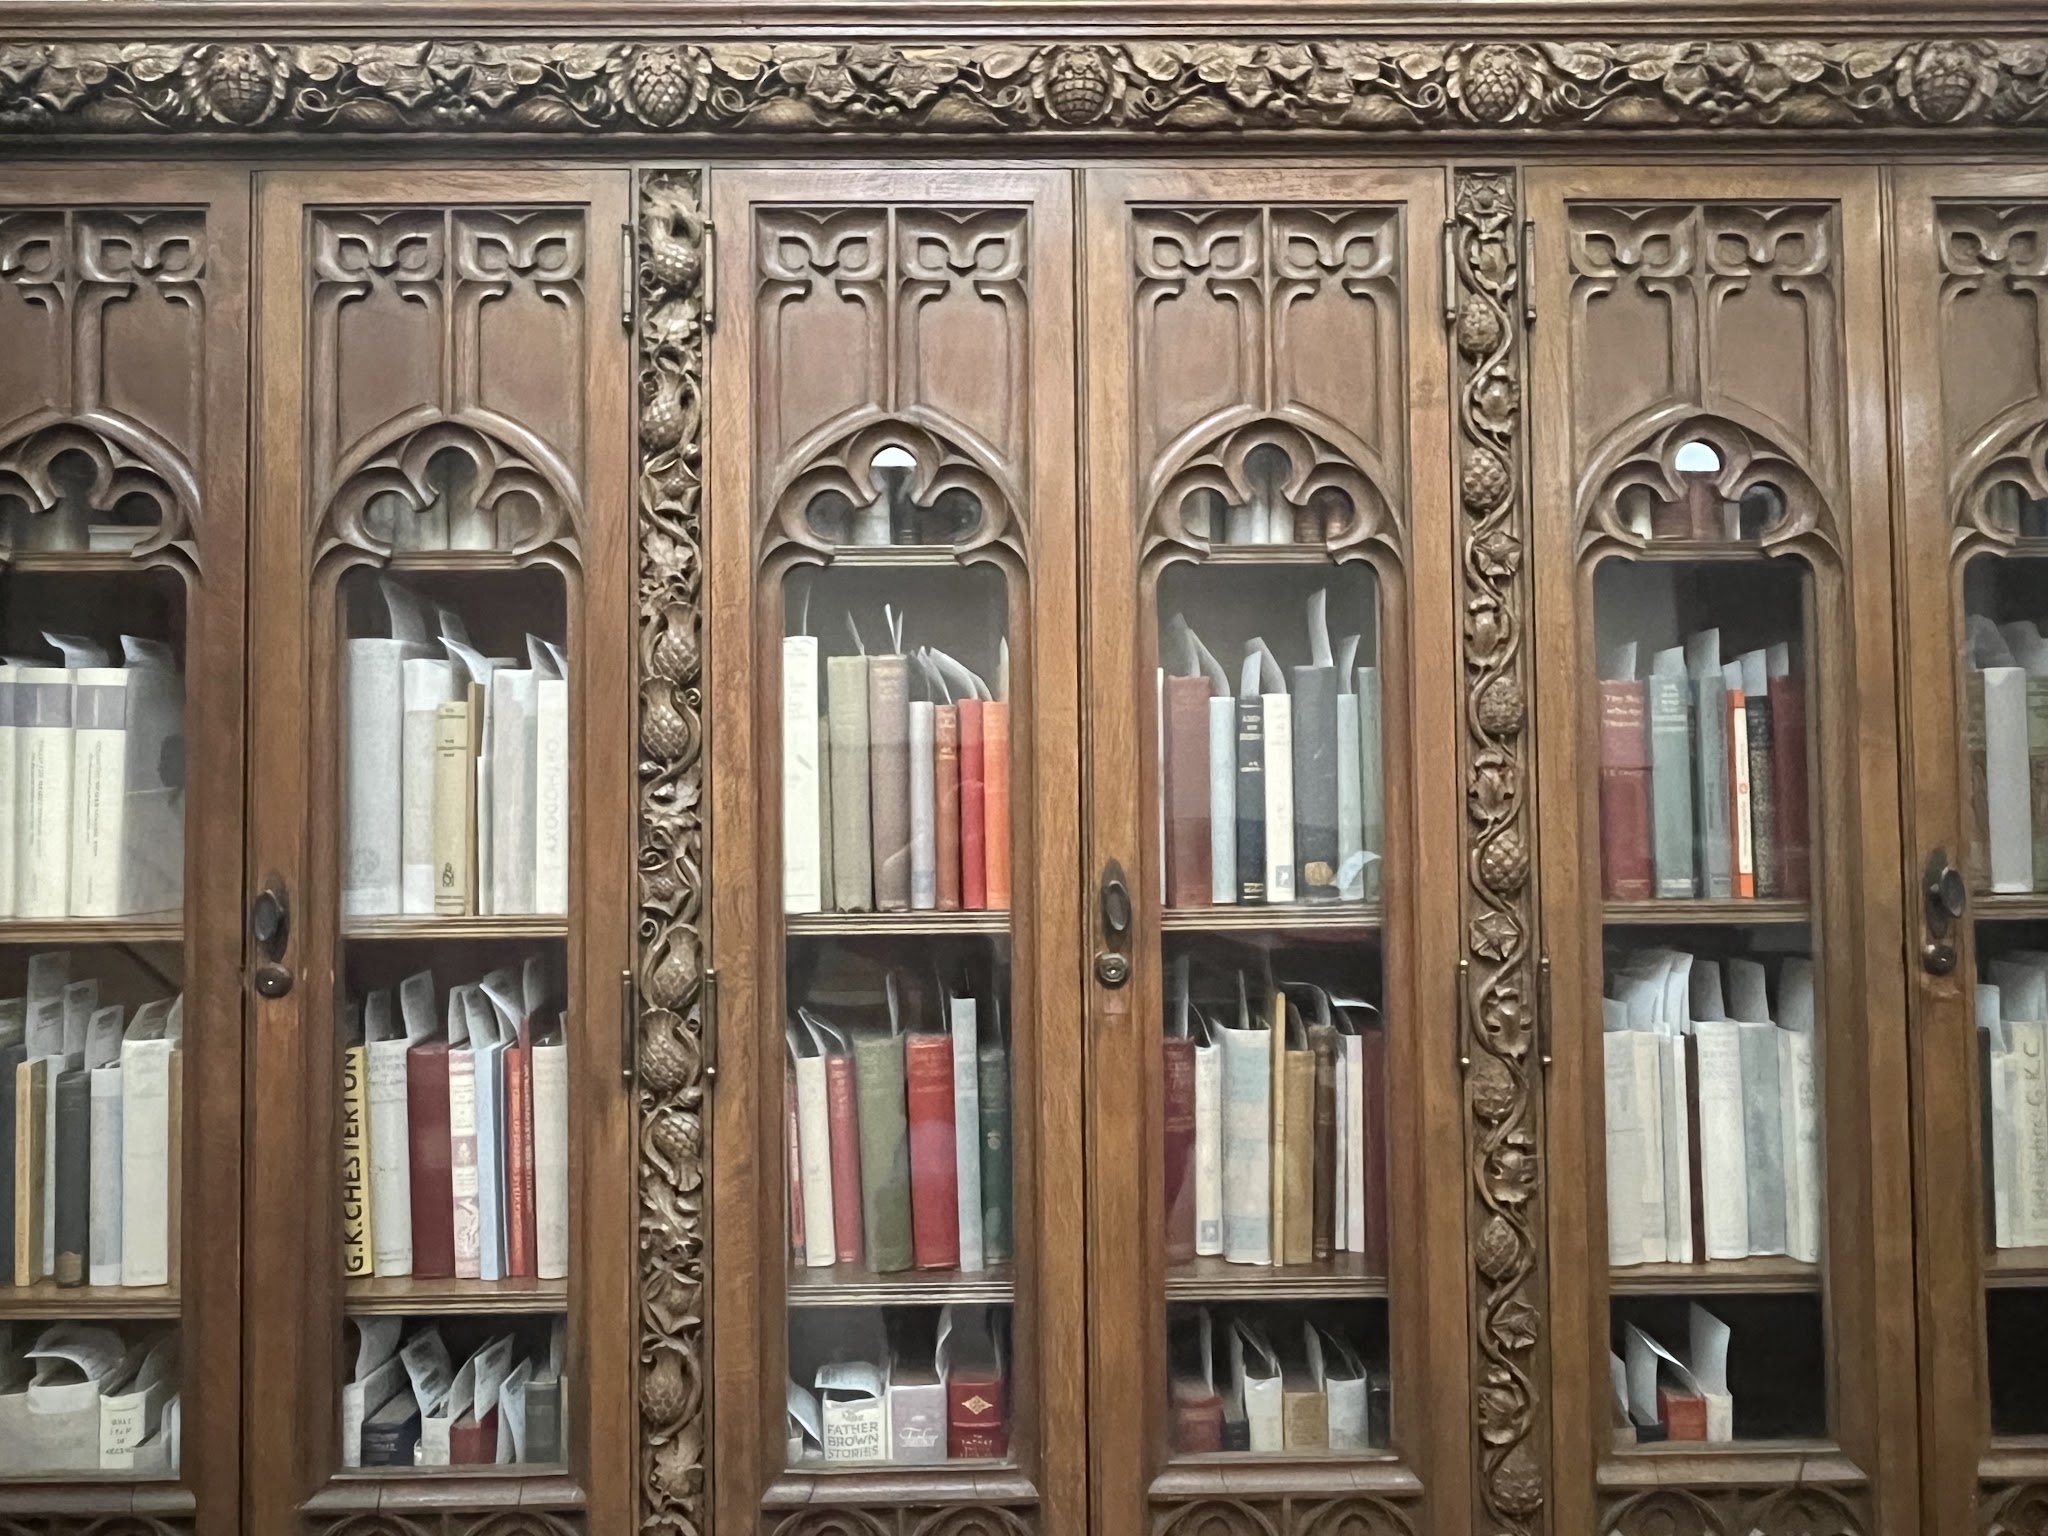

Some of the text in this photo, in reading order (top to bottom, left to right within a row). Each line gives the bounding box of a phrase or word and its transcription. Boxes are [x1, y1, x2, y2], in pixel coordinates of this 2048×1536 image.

[827, 1422, 879, 1435] FATHER
[828, 1433, 879, 1447] BROWN
[828, 1445, 879, 1459] STORIES
